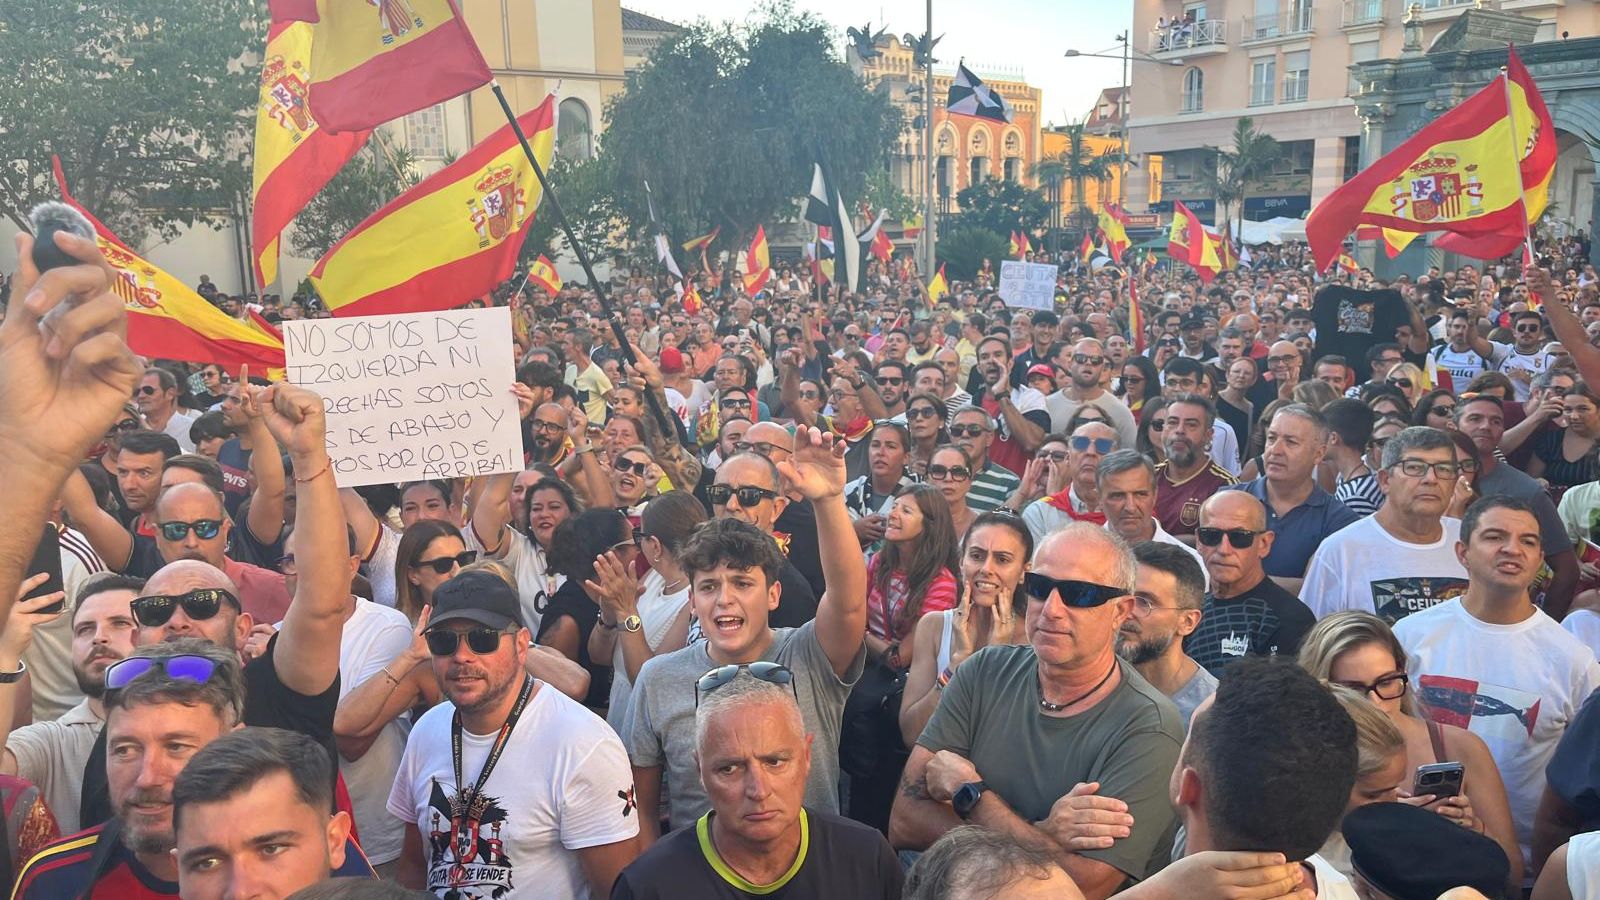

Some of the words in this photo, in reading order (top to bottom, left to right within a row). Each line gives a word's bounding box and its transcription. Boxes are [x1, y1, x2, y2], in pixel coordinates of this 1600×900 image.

[1264, 199, 1288, 208] BBVA
[1002, 264, 1057, 281] CEUTA
[288, 324, 326, 357] NO
[332, 320, 424, 353] SOMOS
[435, 317, 477, 343] DE
[288, 350, 437, 386] IZQUIERDA
[449, 345, 482, 369] NI
[414, 378, 493, 404] SOMOS
[348, 425, 379, 446] DE
[388, 410, 471, 441] ABAJO
[481, 405, 505, 432] Y
[377, 448, 417, 472] POR
[422, 444, 444, 463] LO
[450, 440, 490, 460] DE
[422, 448, 513, 480] ARRIBA!
[1407, 597, 1449, 611] CEUT
[465, 867, 475, 881] SE
[476, 866, 506, 881] VENDE
